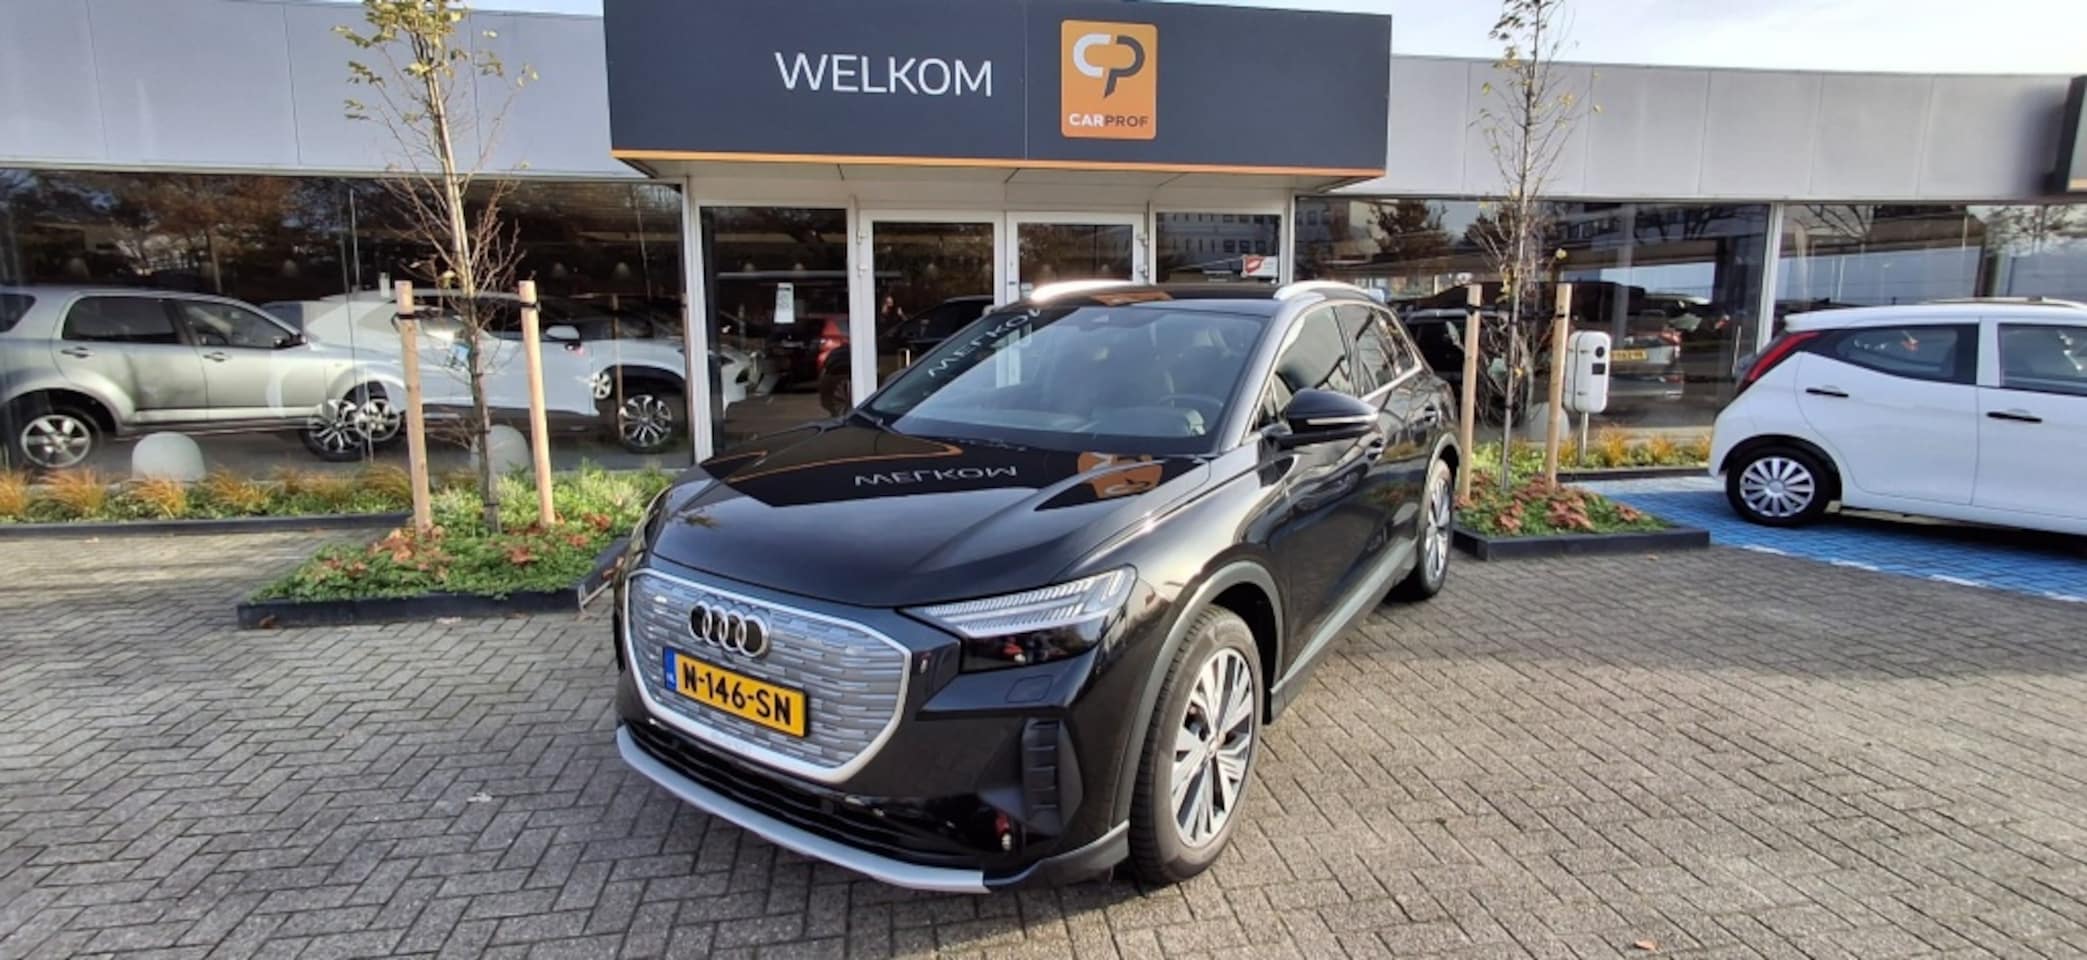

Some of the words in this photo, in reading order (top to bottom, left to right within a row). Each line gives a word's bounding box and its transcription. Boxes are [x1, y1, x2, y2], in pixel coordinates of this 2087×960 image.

[774, 51, 992, 97] WELKOM
[1068, 113, 1149, 128] CARPROF
[682, 661, 792, 727] N-146-SN
